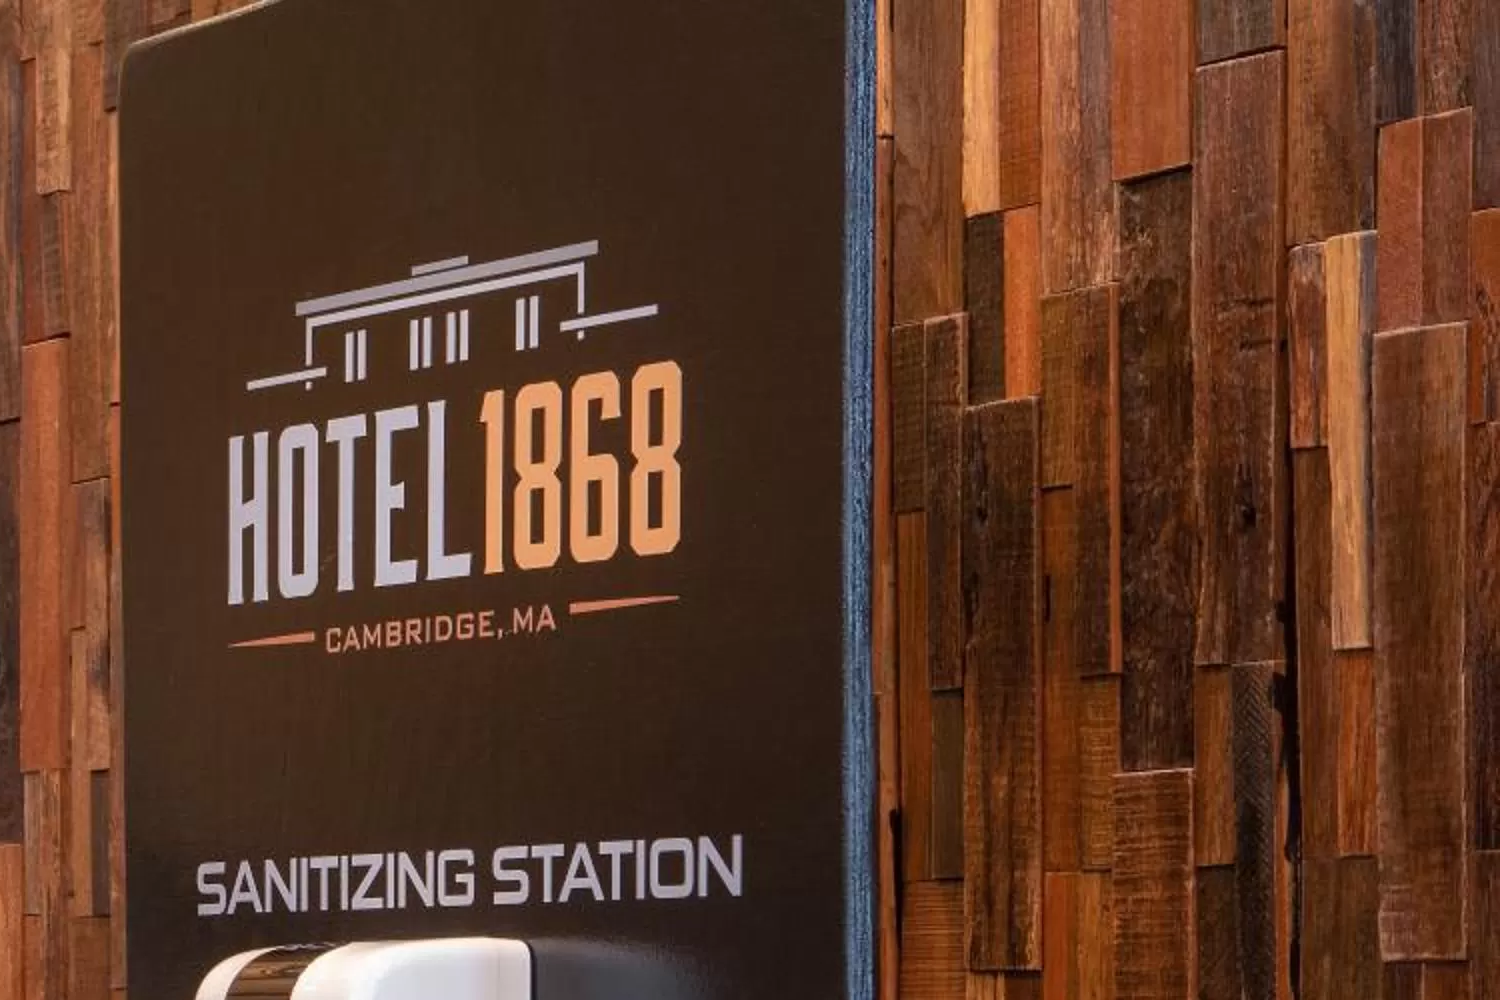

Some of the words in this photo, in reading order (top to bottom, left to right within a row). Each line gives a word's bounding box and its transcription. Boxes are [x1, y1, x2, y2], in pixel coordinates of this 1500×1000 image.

[227, 399, 473, 606] HOTEL
[478, 359, 683, 576] 1868
[325, 609, 504, 654] CAMBRIDGE,
[512, 603, 557, 635] MA
[196, 848, 475, 918] SANITIZING
[491, 834, 742, 905] STATION
